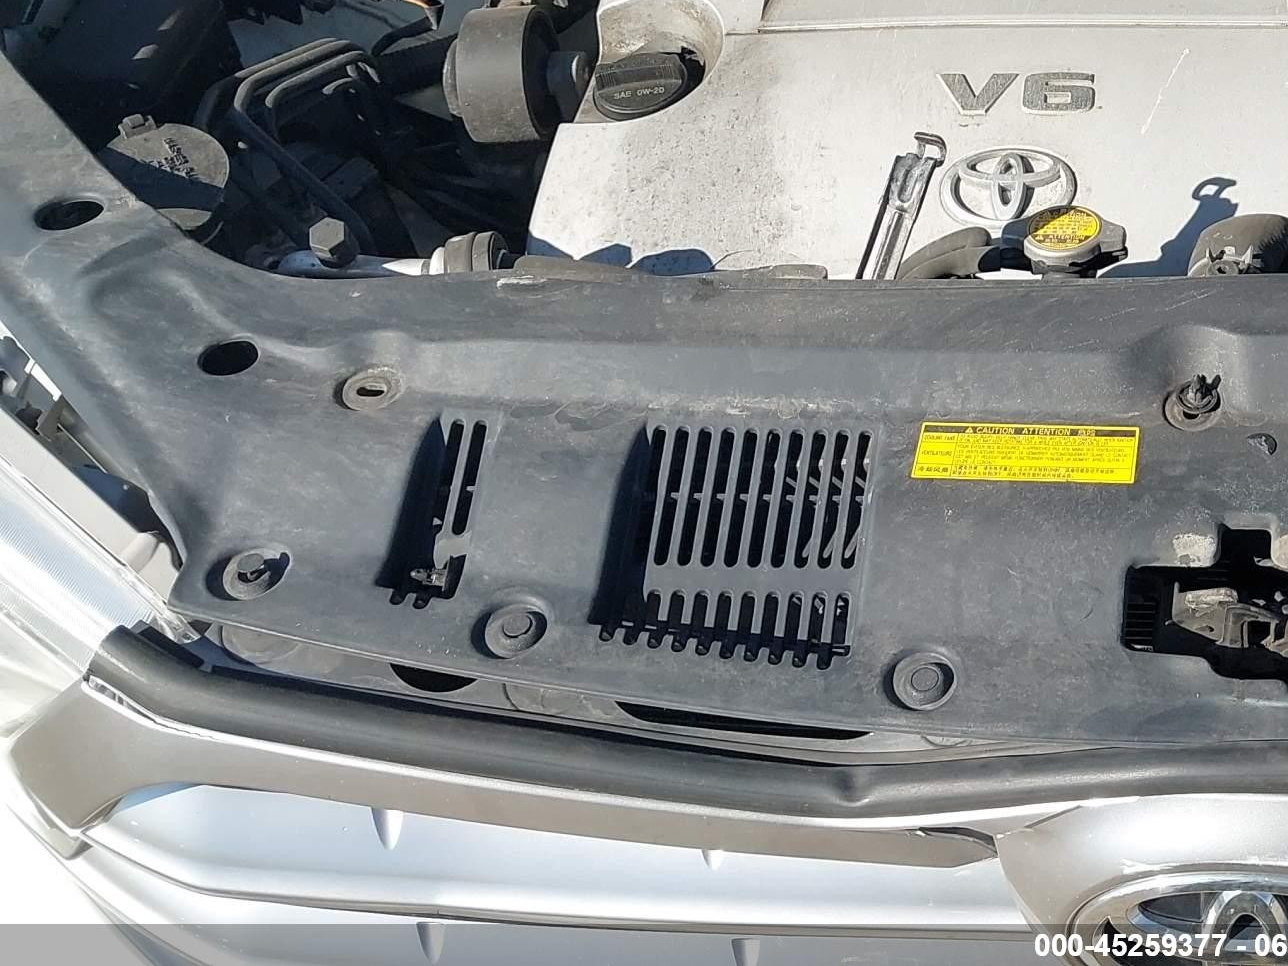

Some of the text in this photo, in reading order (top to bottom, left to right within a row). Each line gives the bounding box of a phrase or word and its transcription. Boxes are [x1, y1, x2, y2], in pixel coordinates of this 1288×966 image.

[614, 90, 632, 100] SAE
[936, 71, 1096, 116] V6
[975, 427, 1071, 435] CAUTION ATTENTION
